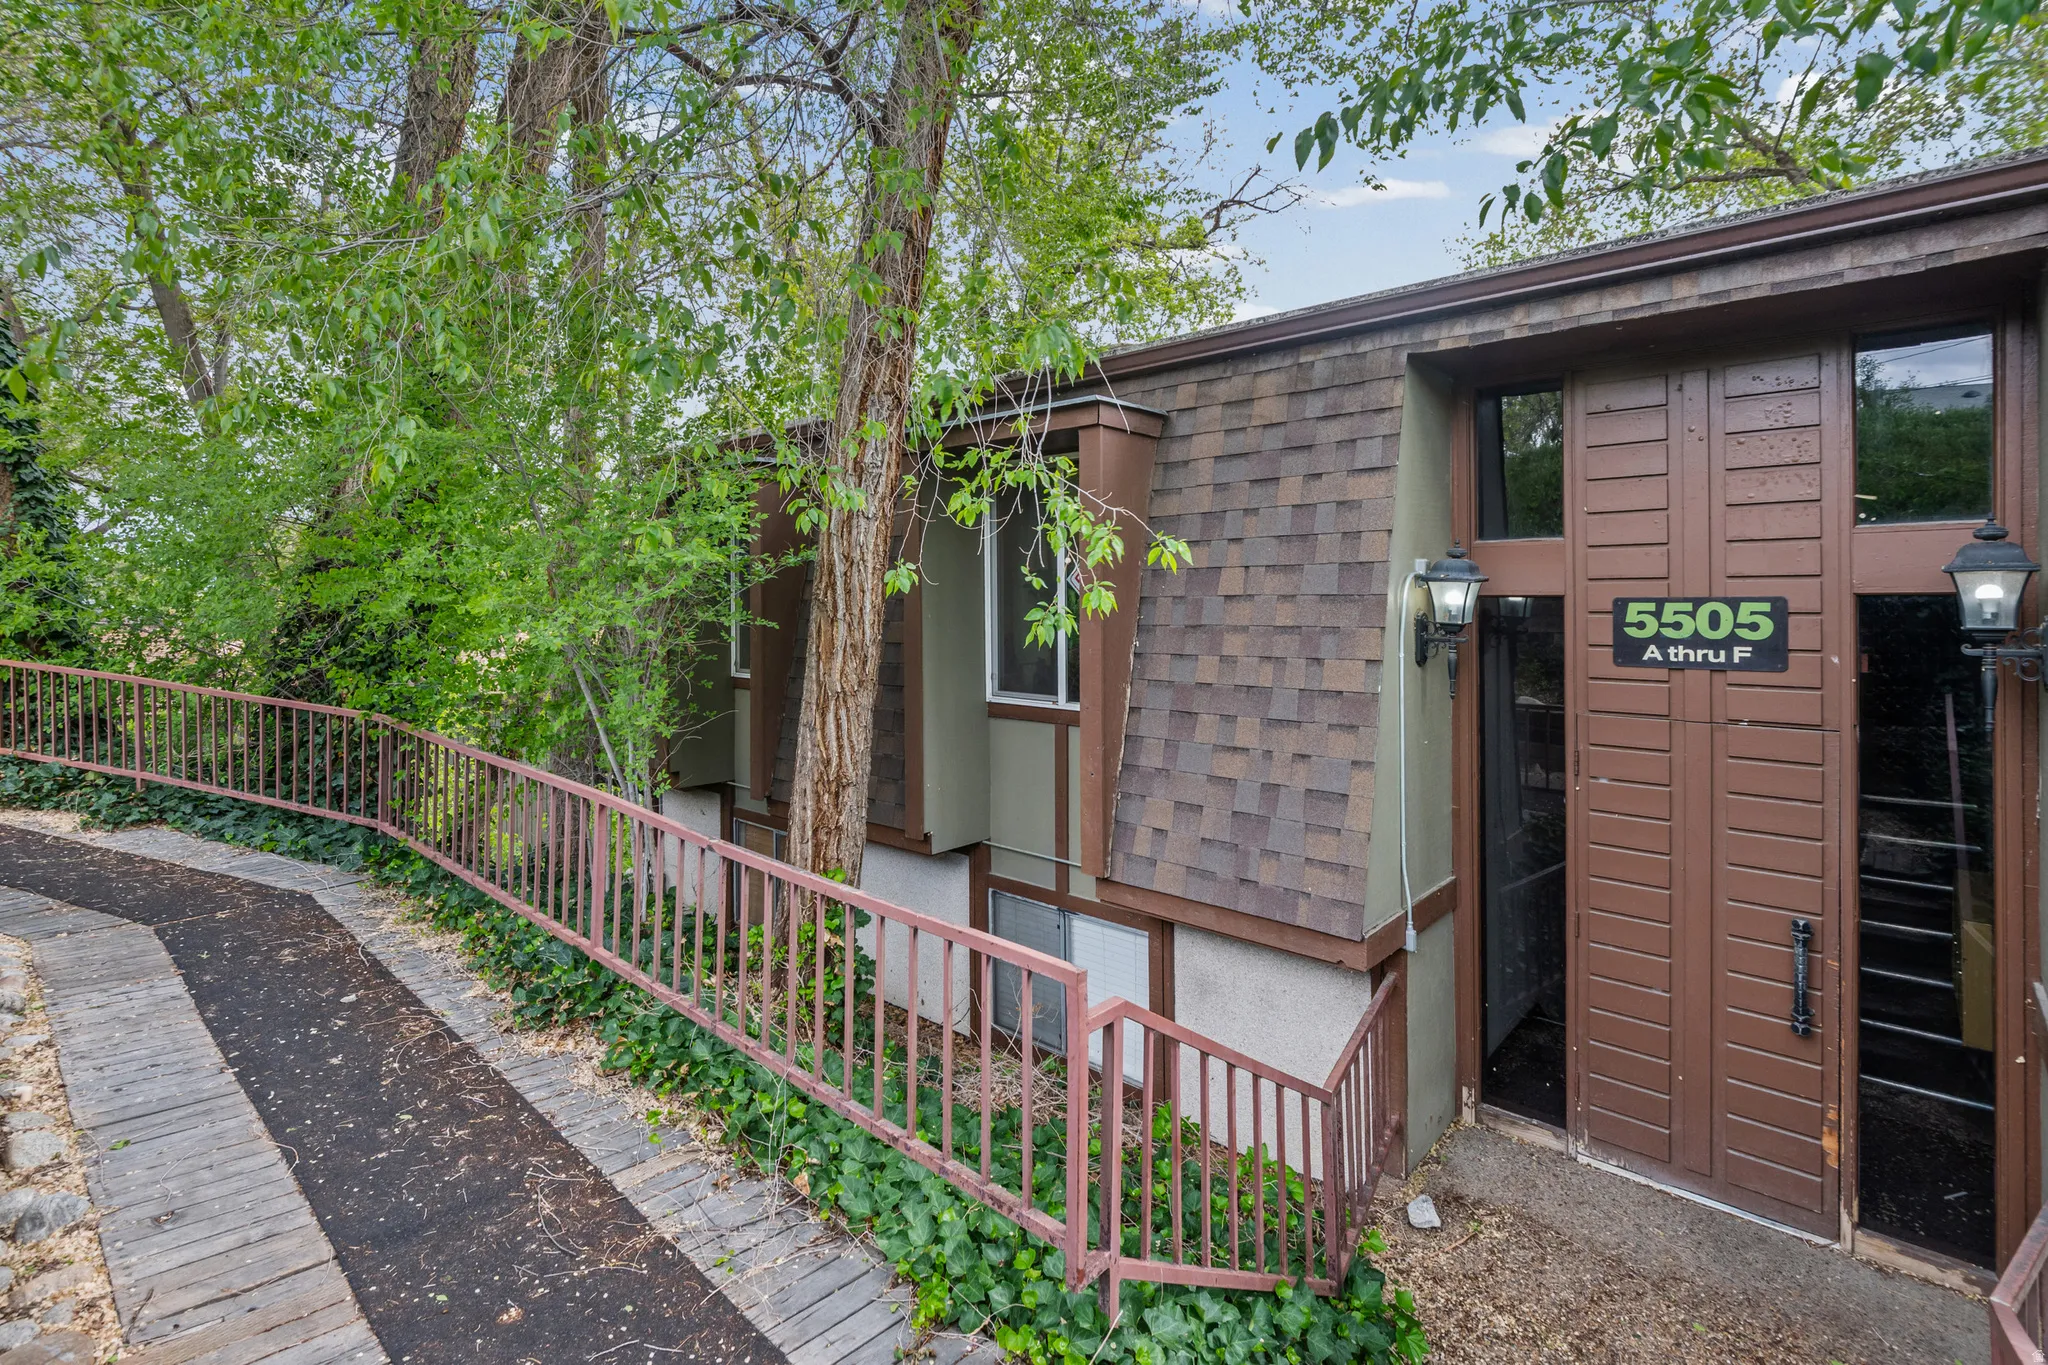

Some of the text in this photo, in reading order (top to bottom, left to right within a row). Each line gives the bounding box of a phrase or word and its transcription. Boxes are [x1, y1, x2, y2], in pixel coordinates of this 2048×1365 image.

[1623, 601, 1774, 641] 5505
[1642, 644, 1752, 663] A thru F
